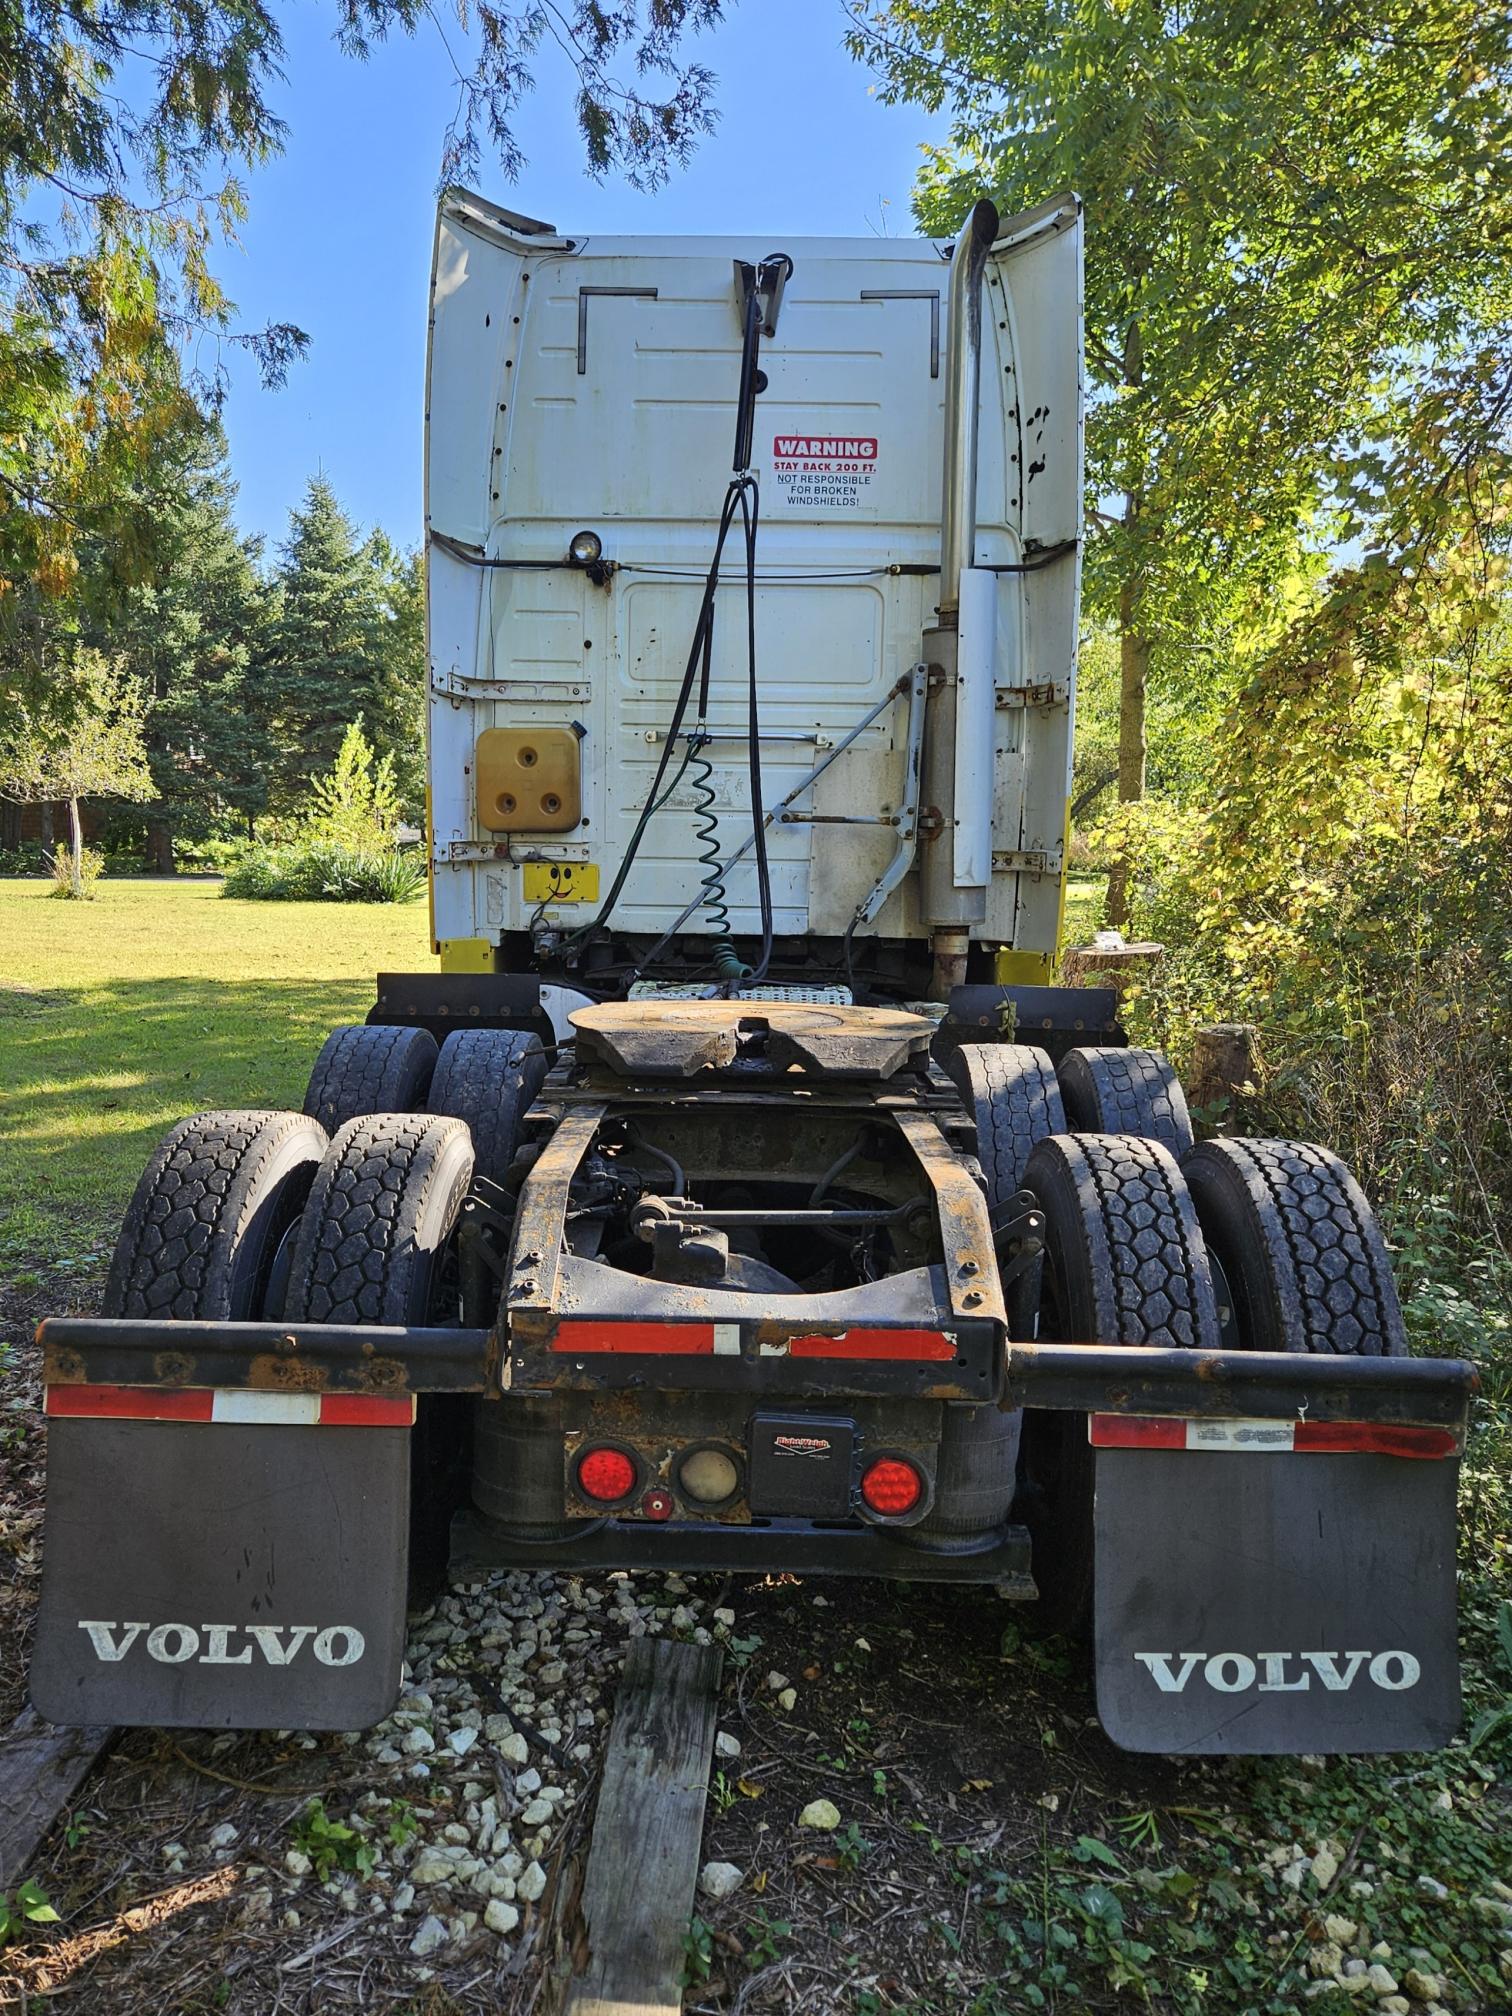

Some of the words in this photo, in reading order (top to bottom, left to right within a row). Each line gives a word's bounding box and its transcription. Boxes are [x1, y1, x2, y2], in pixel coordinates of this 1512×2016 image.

[777, 439, 874, 457] WARNING
[774, 462, 799, 470] STAY
[803, 462, 831, 471] BACK
[836, 463, 858, 472] 200
[863, 464, 876, 472] FT.
[777, 475, 798, 484] NOT
[801, 475, 871, 484] RESPONSIBLE
[791, 485, 811, 494] FOR
[814, 486, 856, 495] BROKEN
[787, 496, 859, 506] WINDSHIELDS!
[78, 1620, 365, 1666] VOLVO
[1134, 1650, 1420, 1692] VOLVO
